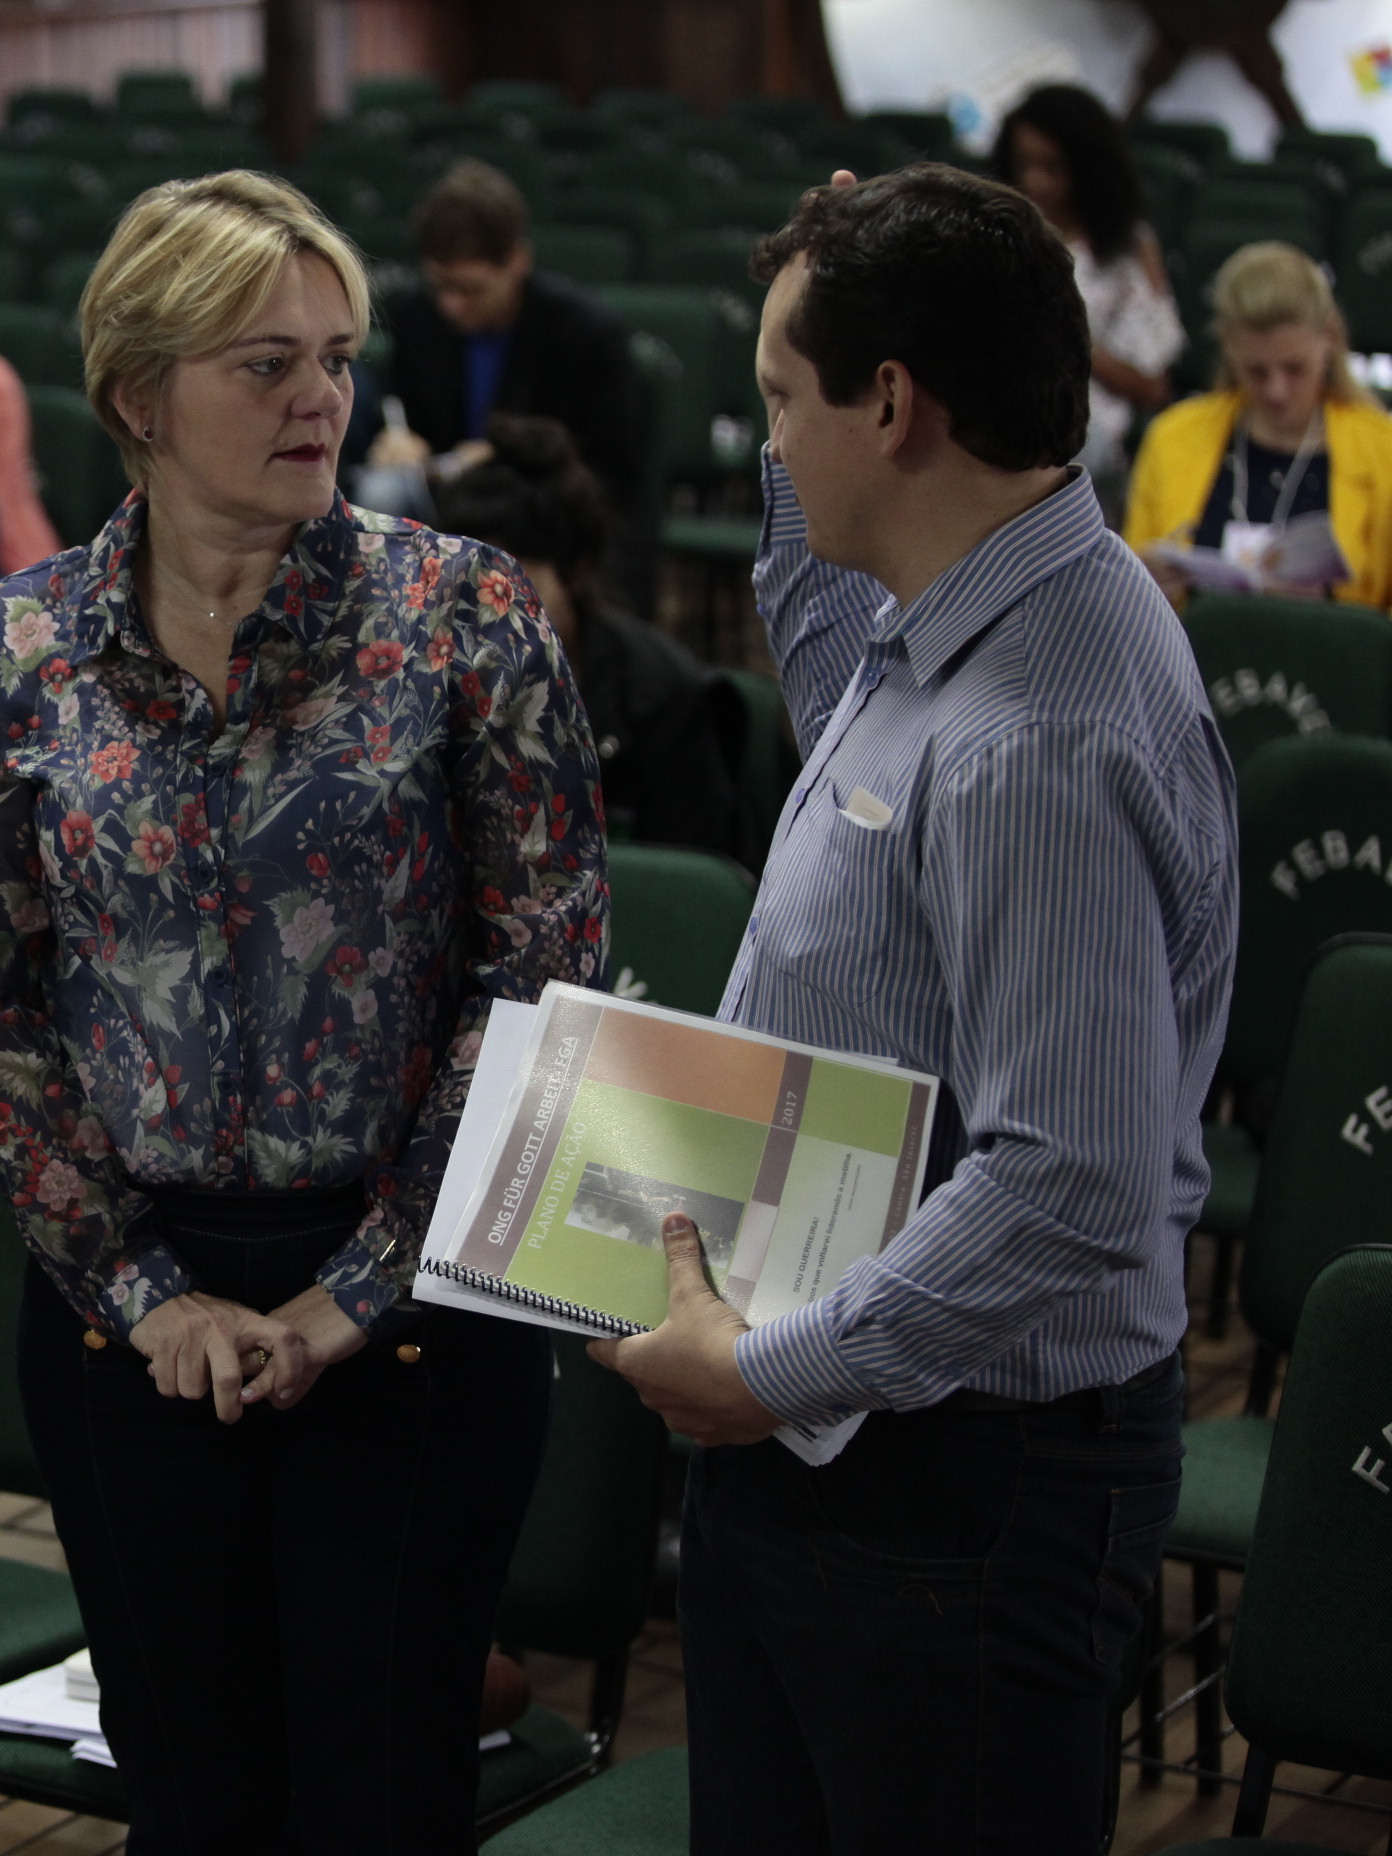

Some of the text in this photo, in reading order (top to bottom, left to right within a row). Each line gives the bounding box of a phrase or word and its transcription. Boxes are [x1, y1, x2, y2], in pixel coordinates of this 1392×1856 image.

[1270, 829, 1392, 902] FEBA
[781, 1090, 798, 1124] 2017
[488, 1211, 512, 1245] ONG
[503, 1178, 525, 1210] FÜR
[517, 1132, 542, 1175] GOTT
[528, 1121, 587, 1249] PLANO DE AÇÃO
[793, 1216, 820, 1293] SOU GUERREIRA!
[813, 1269, 822, 1286] que
[819, 1235, 831, 1268] voltarei
[827, 1193, 842, 1234] liderando
